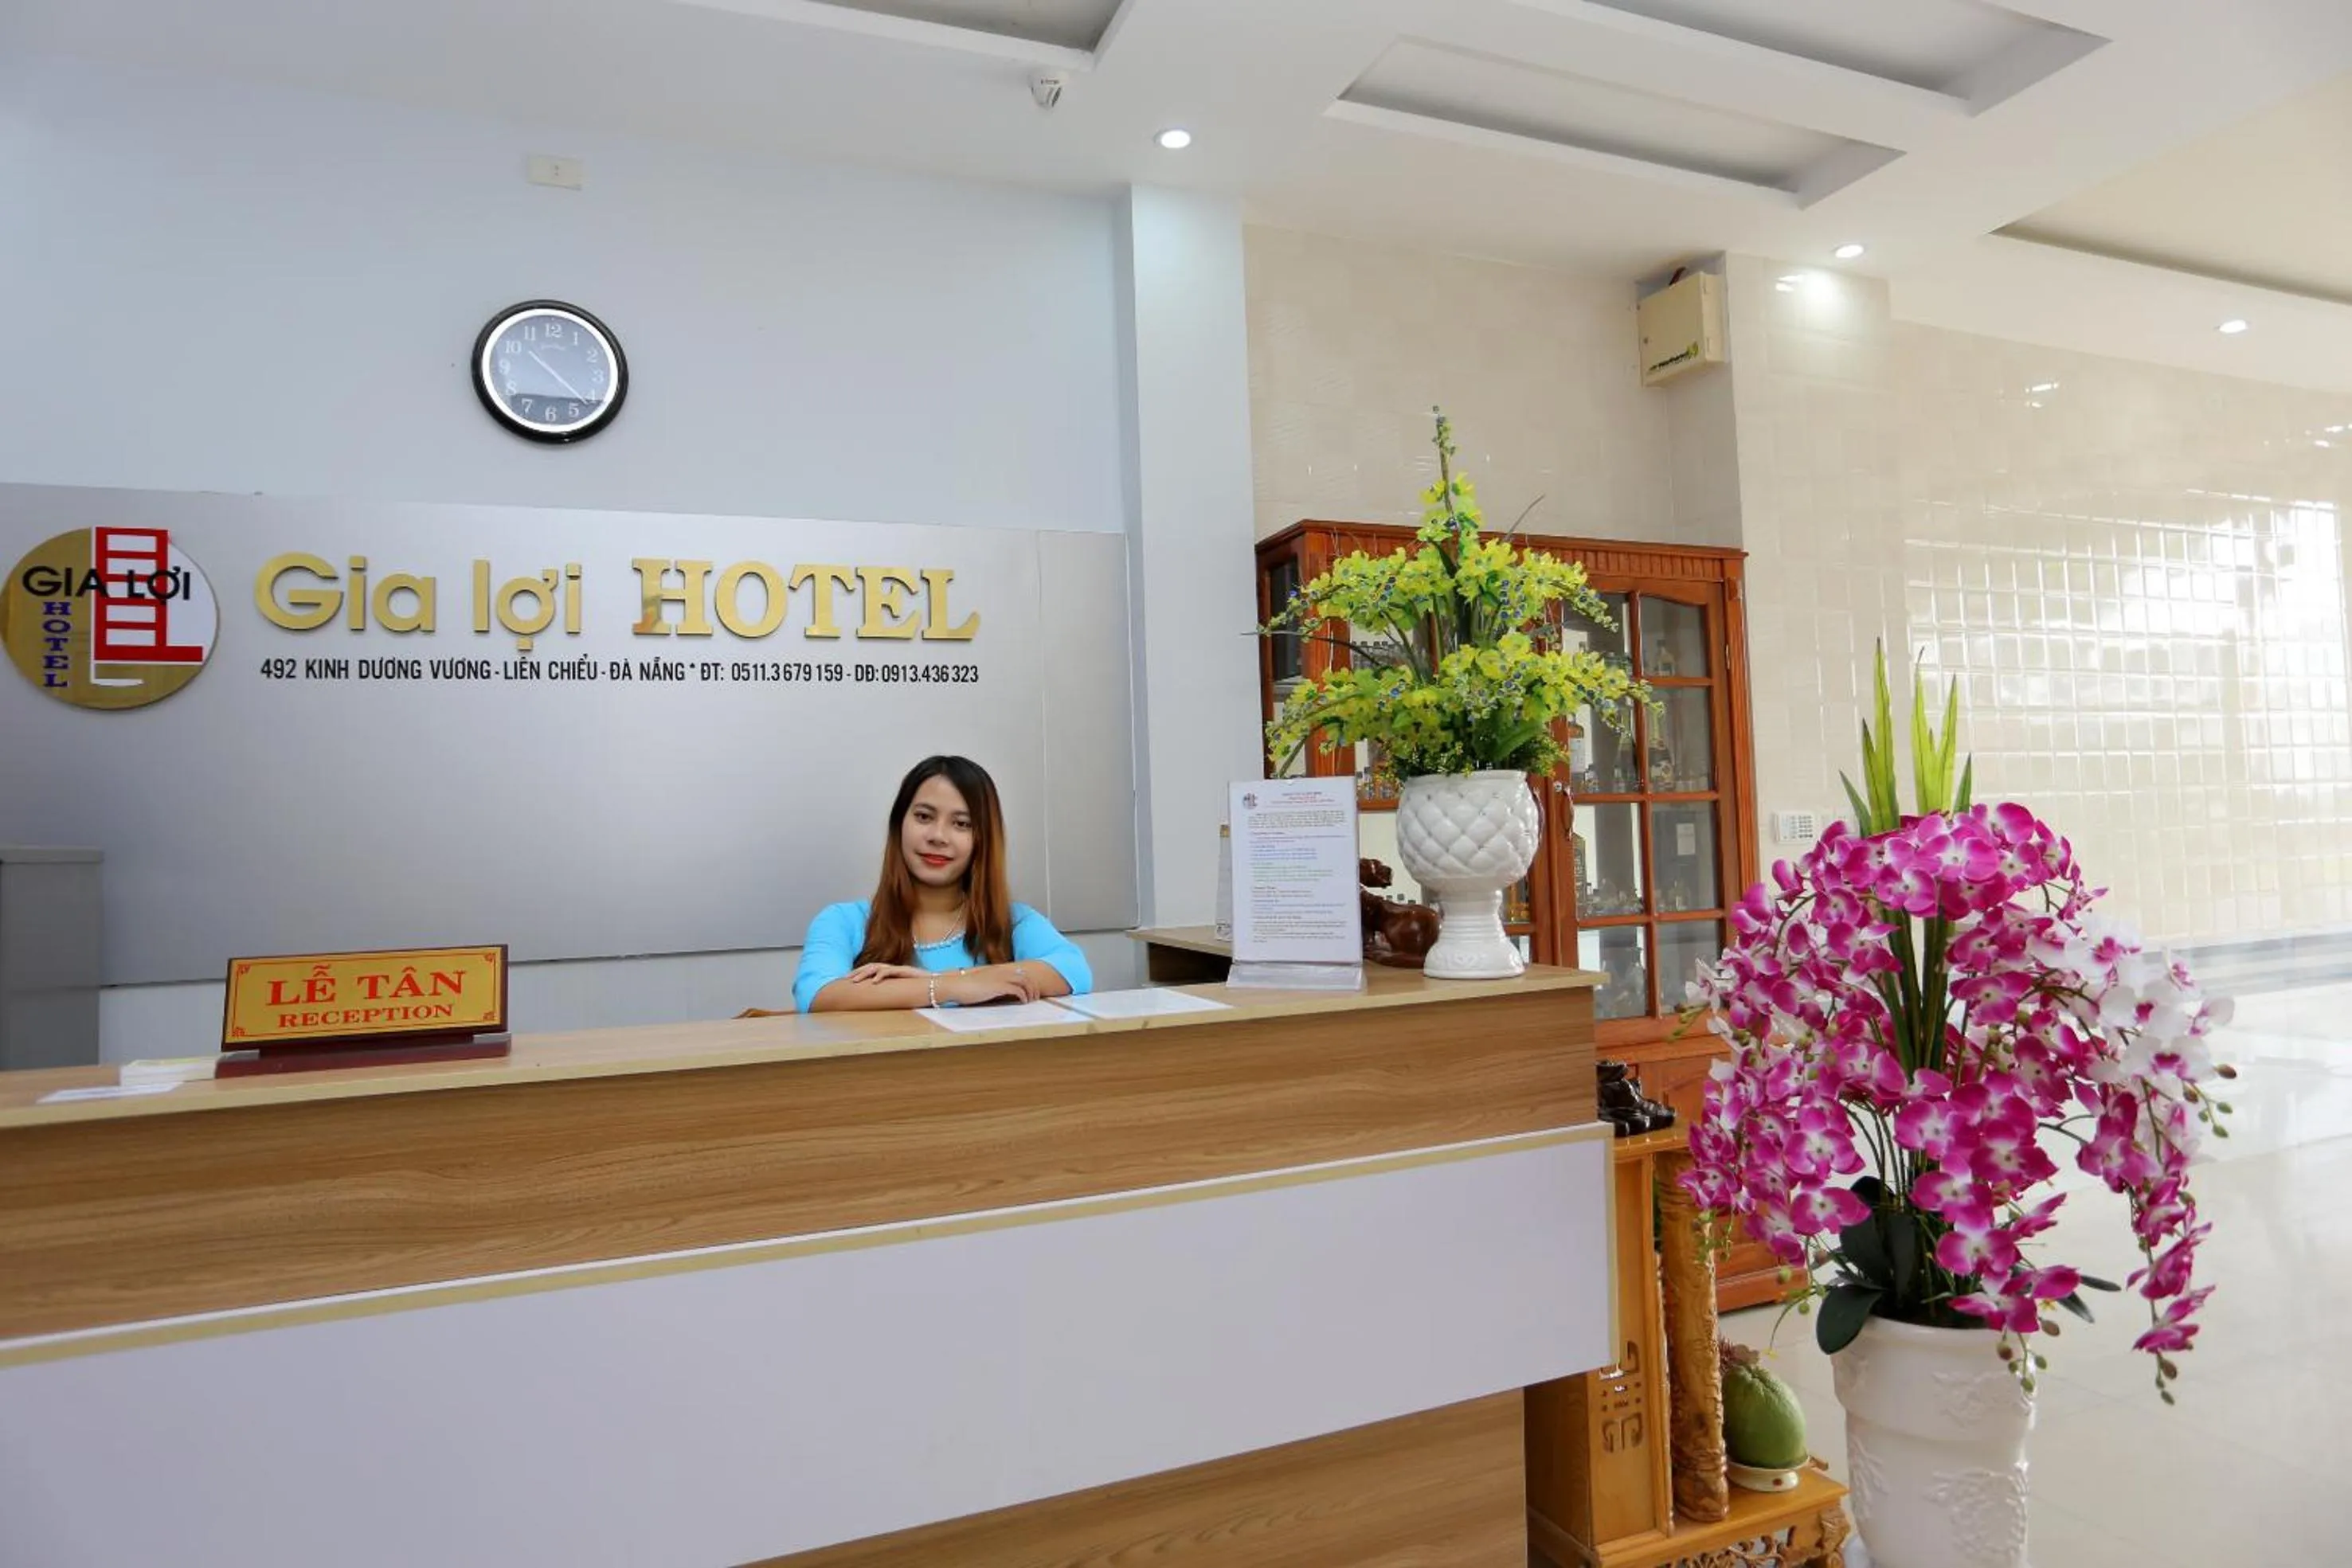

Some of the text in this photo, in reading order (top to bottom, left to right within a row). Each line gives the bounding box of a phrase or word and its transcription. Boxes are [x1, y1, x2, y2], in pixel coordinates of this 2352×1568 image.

[523, 326, 536, 341] 11
[545, 323, 562, 338] 12
[573, 331, 578, 346] 1
[505, 340, 522, 354] 10
[587, 350, 598, 362] 2
[499, 360, 511, 374] 9
[506, 380, 517, 395] 8
[522, 398, 533, 413] 7
[569, 403, 579, 416] 5
[545, 406, 557, 421] 6
[22, 566, 190, 604] GIA LỢI
[254, 552, 981, 651] Gia lợi HOTEL
[42, 601, 72, 687] HOTEL
[260, 659, 297, 678] 492
[306, 659, 349, 679] KINH
[358, 657, 421, 679] DƯƠNG
[609, 658, 632, 681] ĐÀ
[265, 964, 467, 1006] LỄ TÂN
[278, 1003, 455, 1028] RECEPTION
